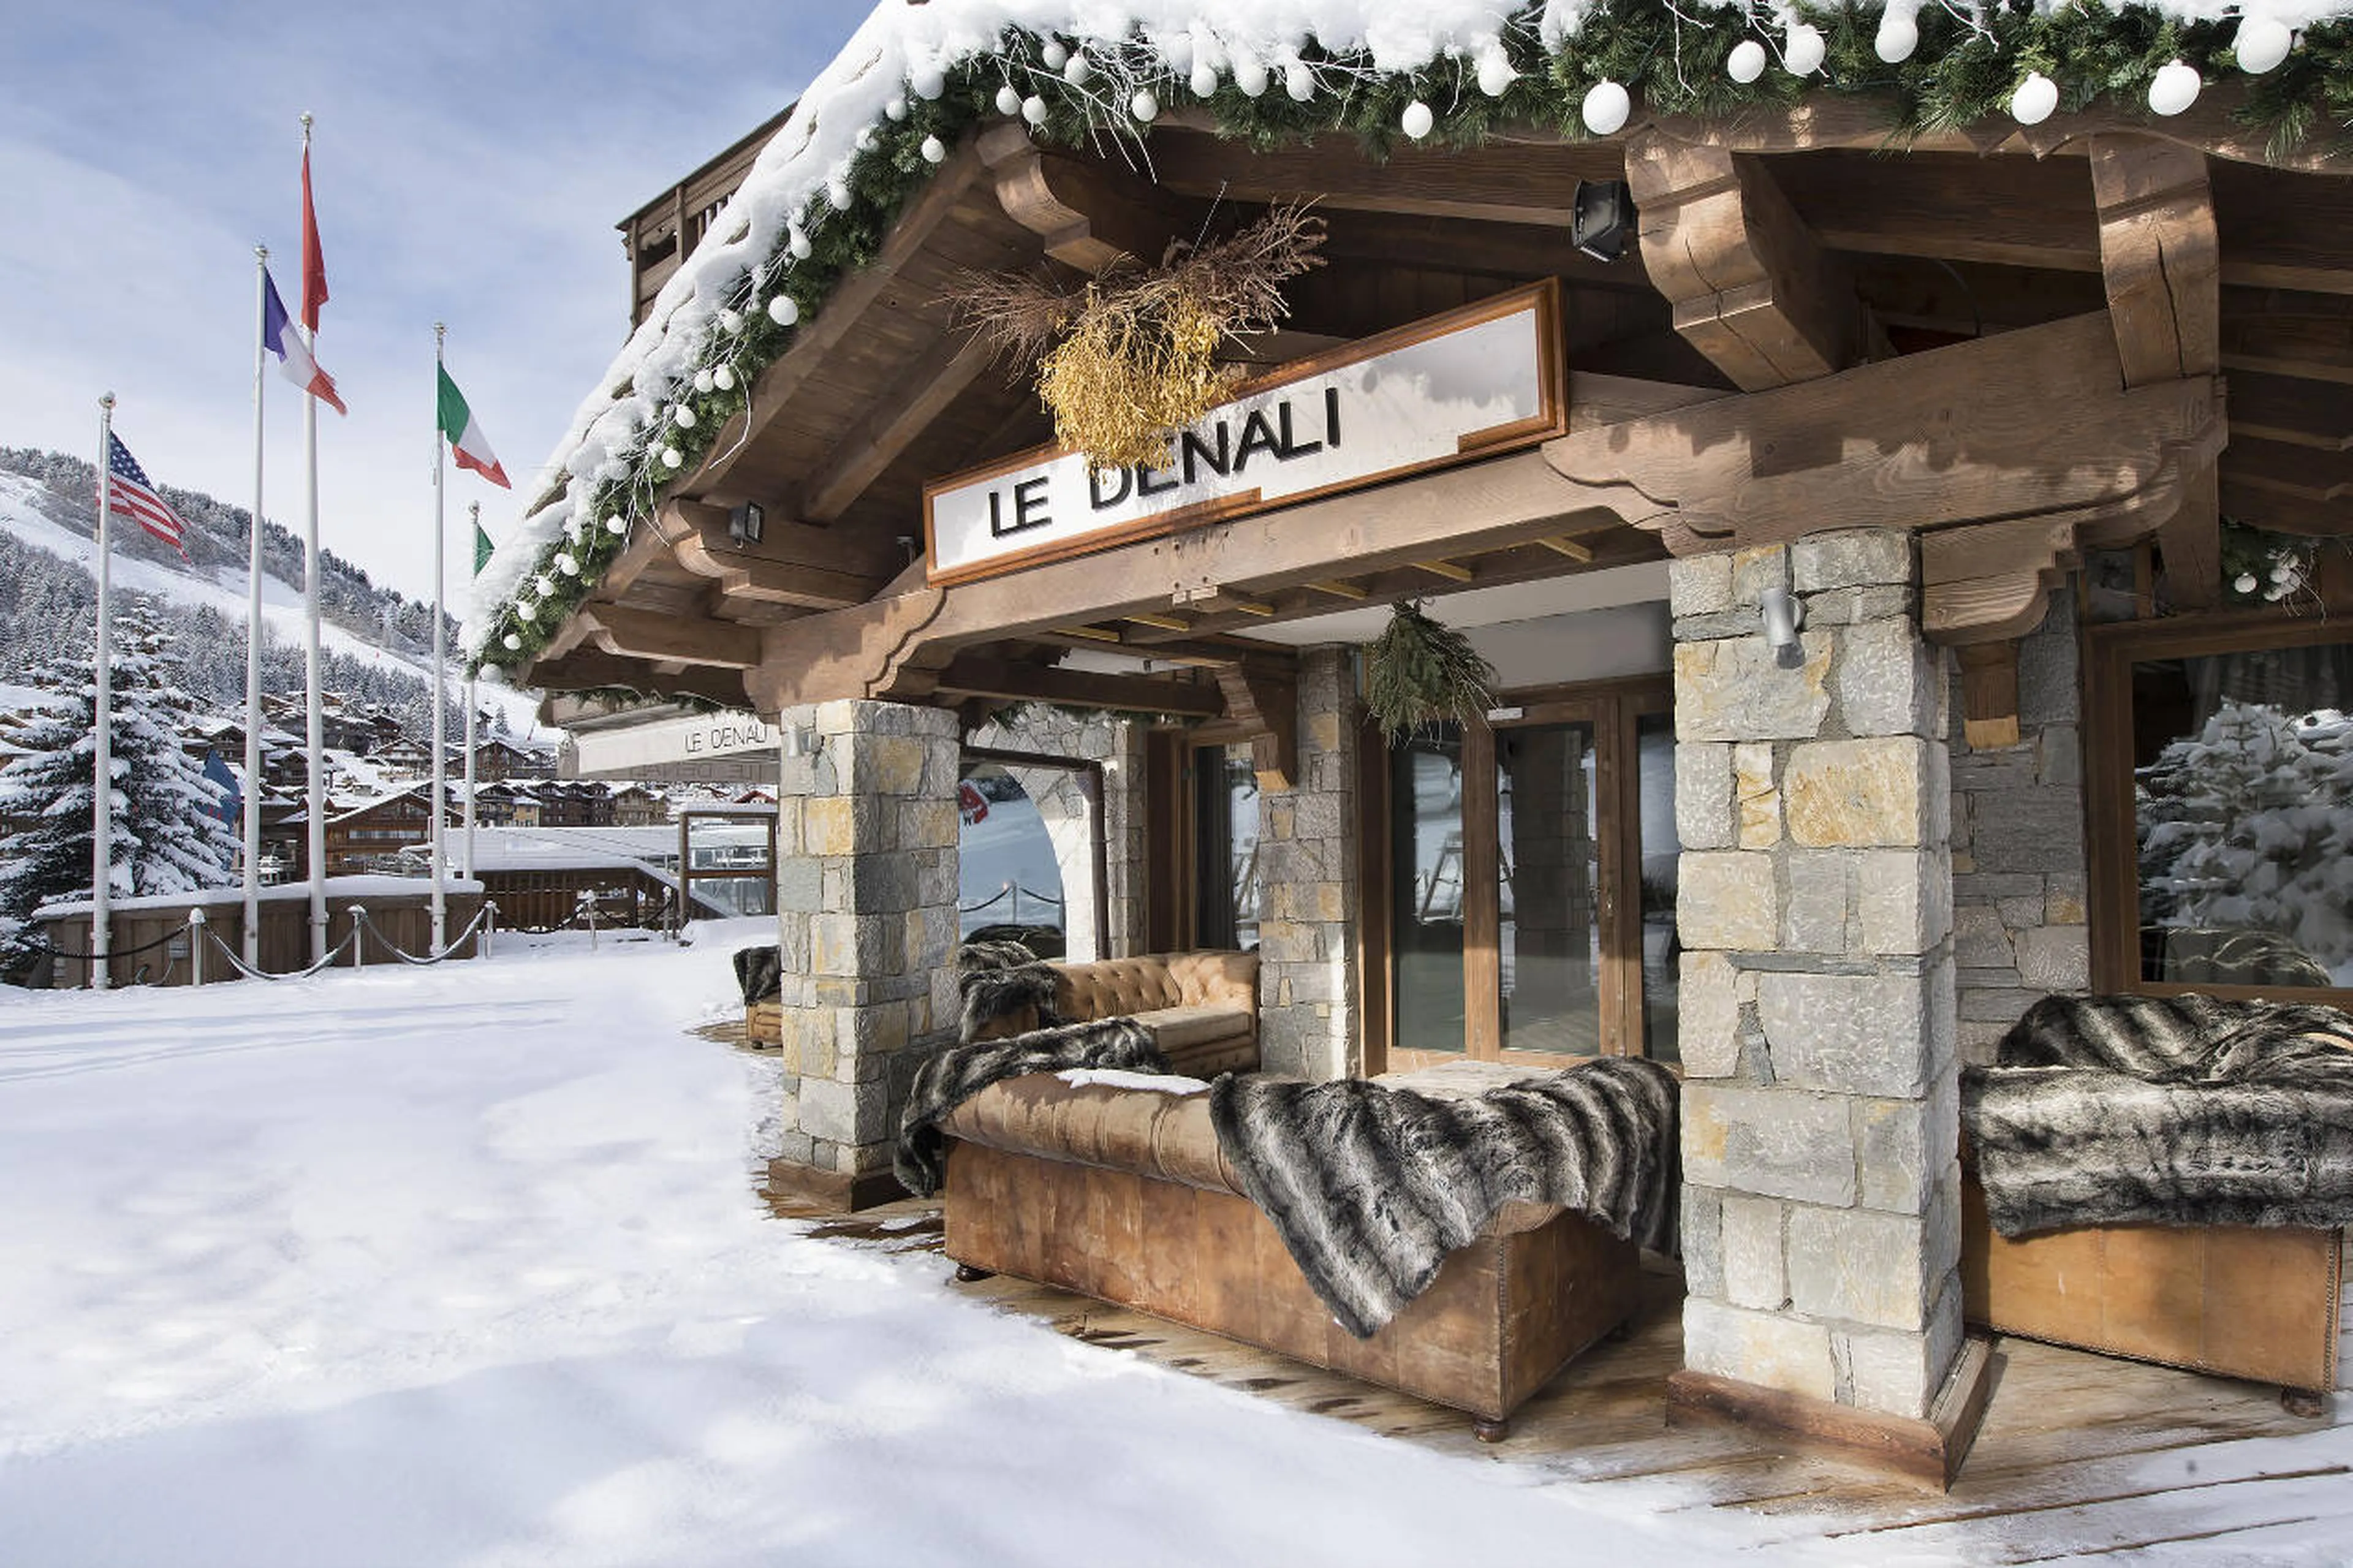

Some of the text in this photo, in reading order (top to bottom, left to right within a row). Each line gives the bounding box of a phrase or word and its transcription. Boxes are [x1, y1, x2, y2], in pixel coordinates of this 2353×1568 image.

[988, 476, 1052, 537] LE
[685, 724, 767, 752] LE DENALI
